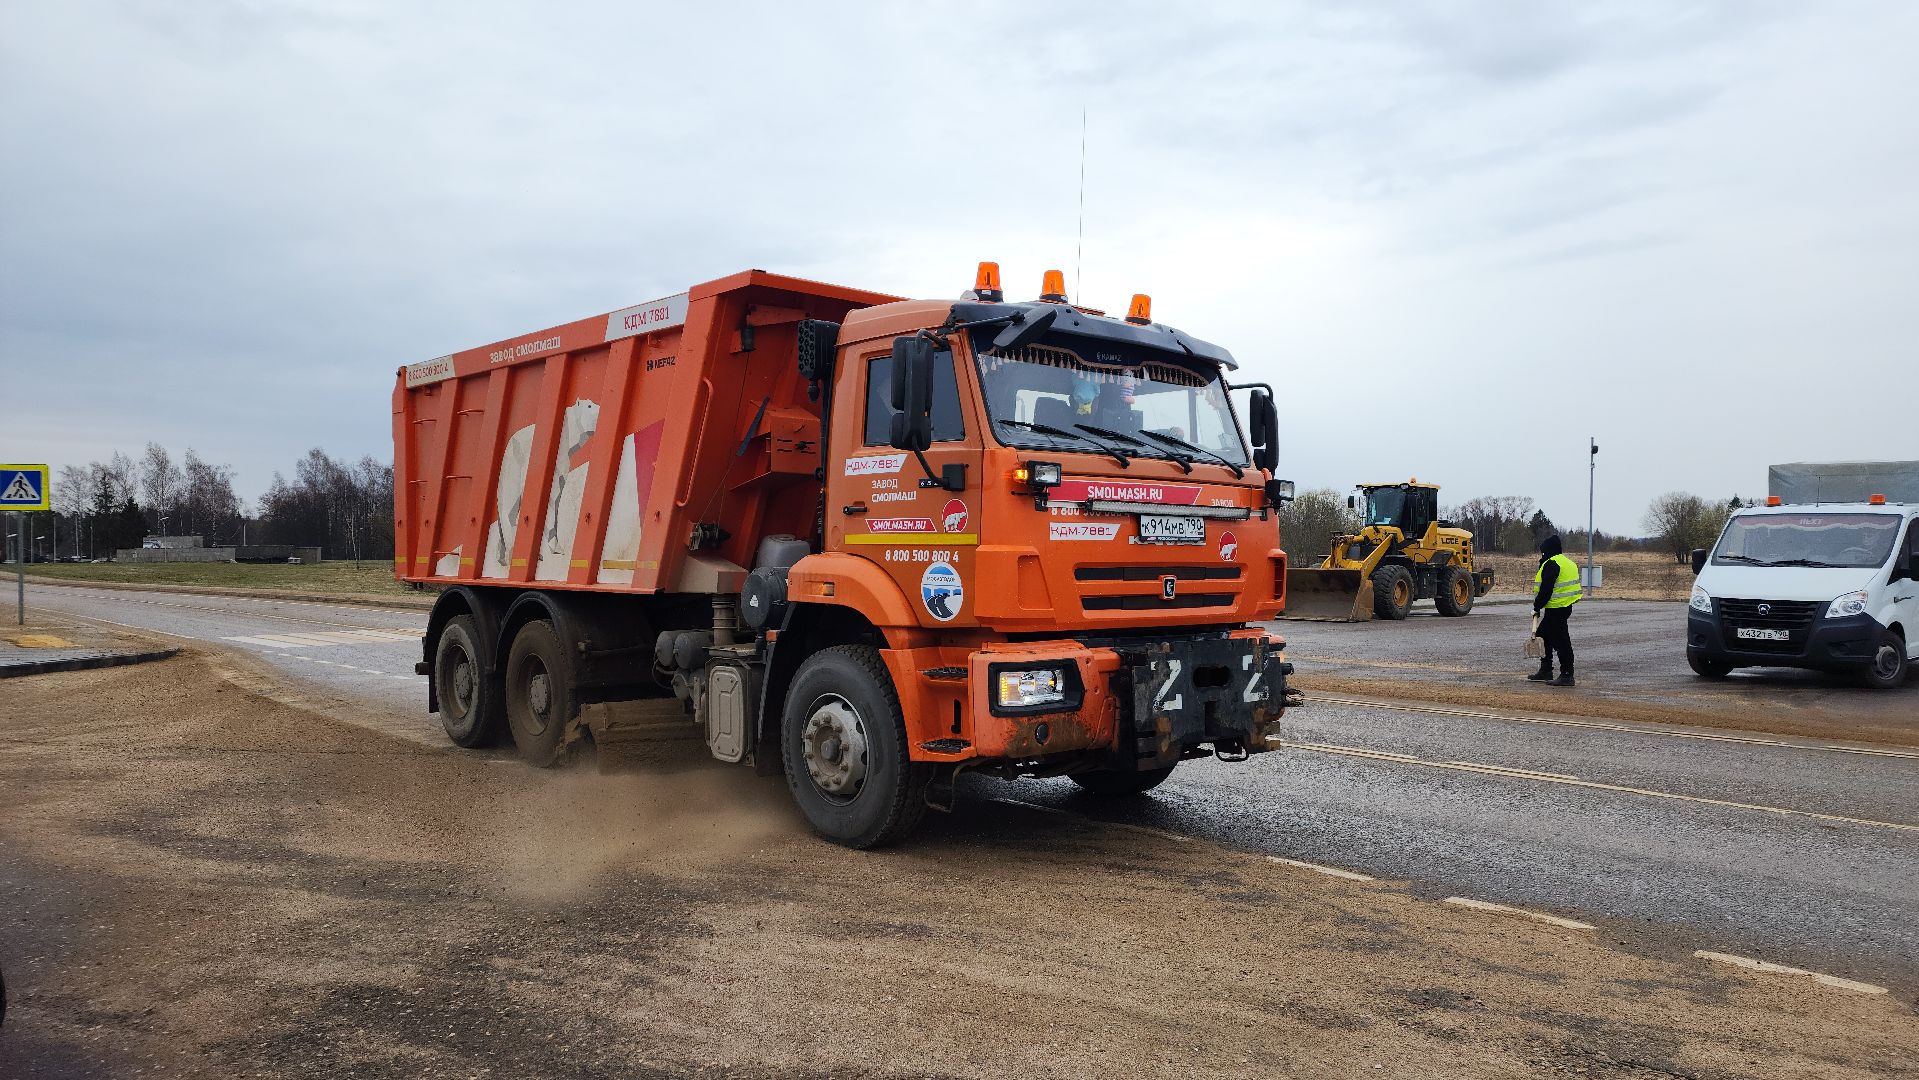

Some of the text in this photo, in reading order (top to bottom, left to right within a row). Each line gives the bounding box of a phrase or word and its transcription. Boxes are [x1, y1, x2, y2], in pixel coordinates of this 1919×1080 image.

[624, 305, 670, 331] КДМ 7881
[846, 459, 900, 472] КДМ-7881
[871, 479, 898, 489] ЗАВОД
[871, 491, 917, 503] СМОЛМАШ
[1087, 485, 1164, 500] SMOLMASH.RU
[872, 520, 927, 530] SMOLMASH.RU
[1050, 526, 1113, 538] КДМ-7881
[885, 549, 959, 563] 8 800 500 800 4
